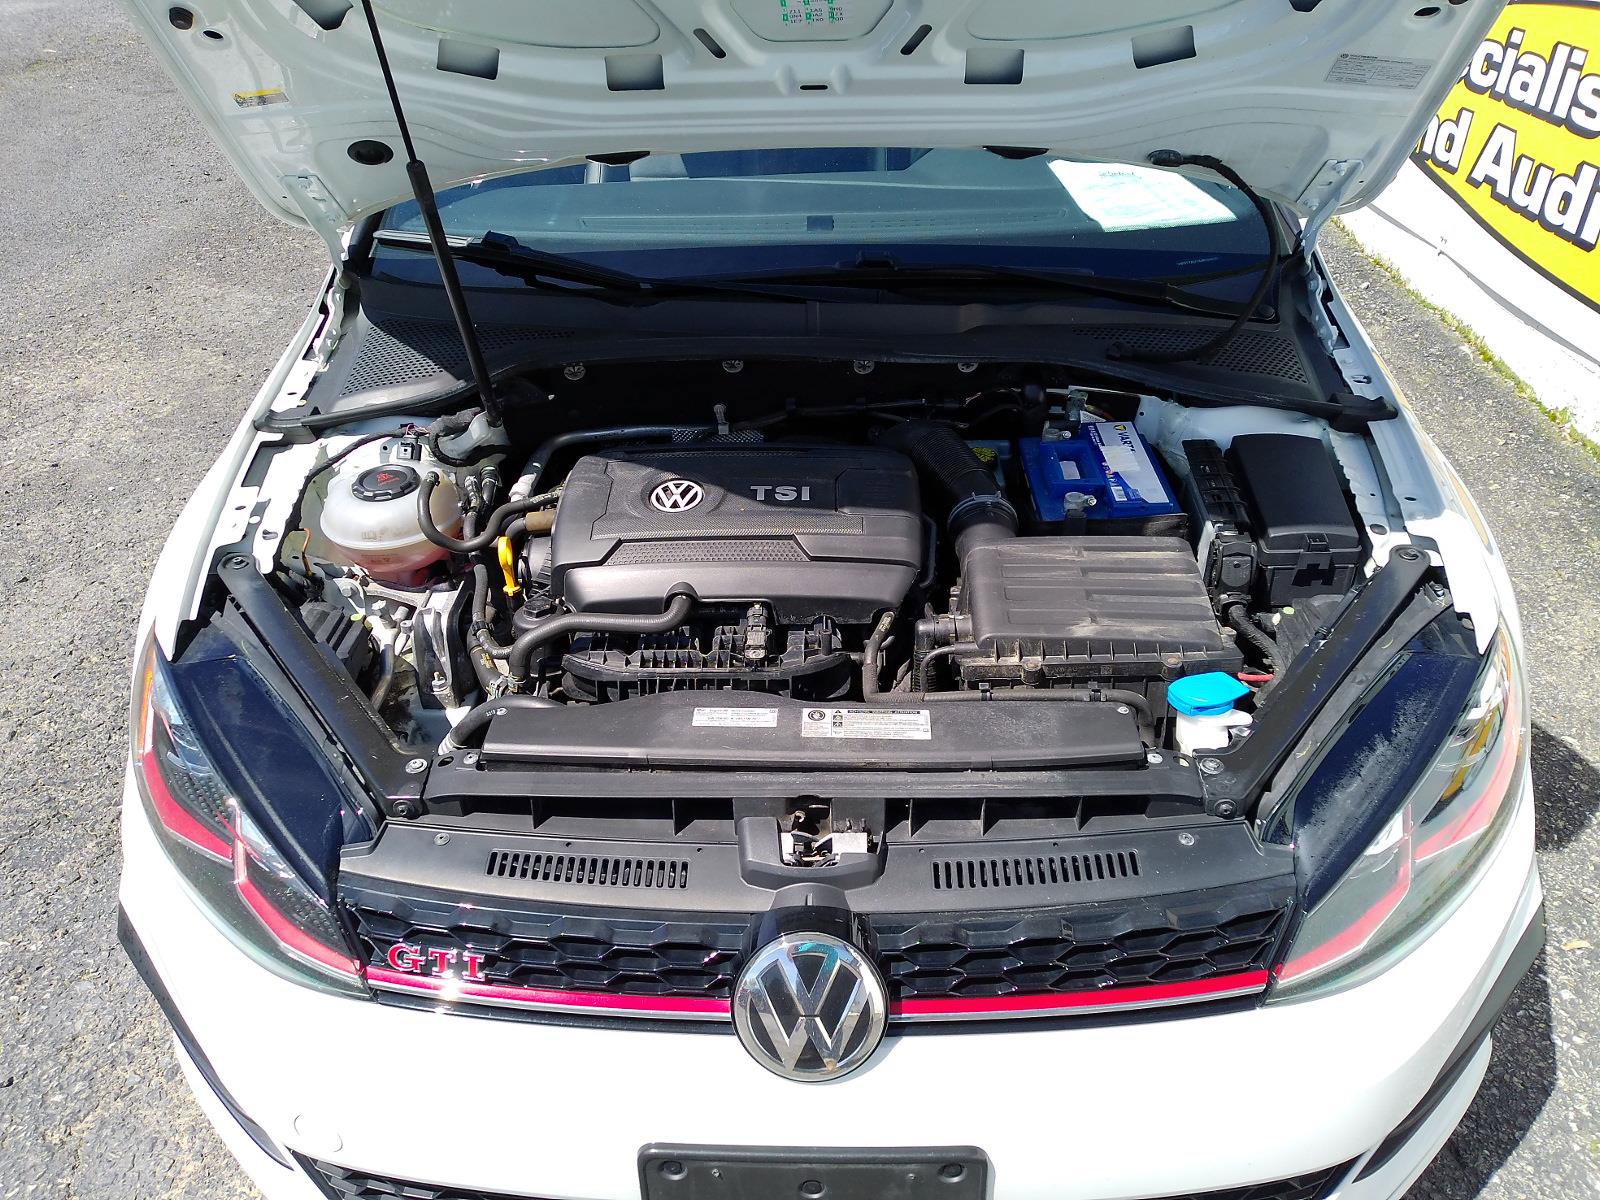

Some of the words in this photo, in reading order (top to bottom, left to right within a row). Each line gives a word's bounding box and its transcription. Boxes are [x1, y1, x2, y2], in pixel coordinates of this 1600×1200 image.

[1459, 27, 1600, 138] cialis
[750, 485, 810, 501] TSI
[388, 943, 486, 982] GTI
